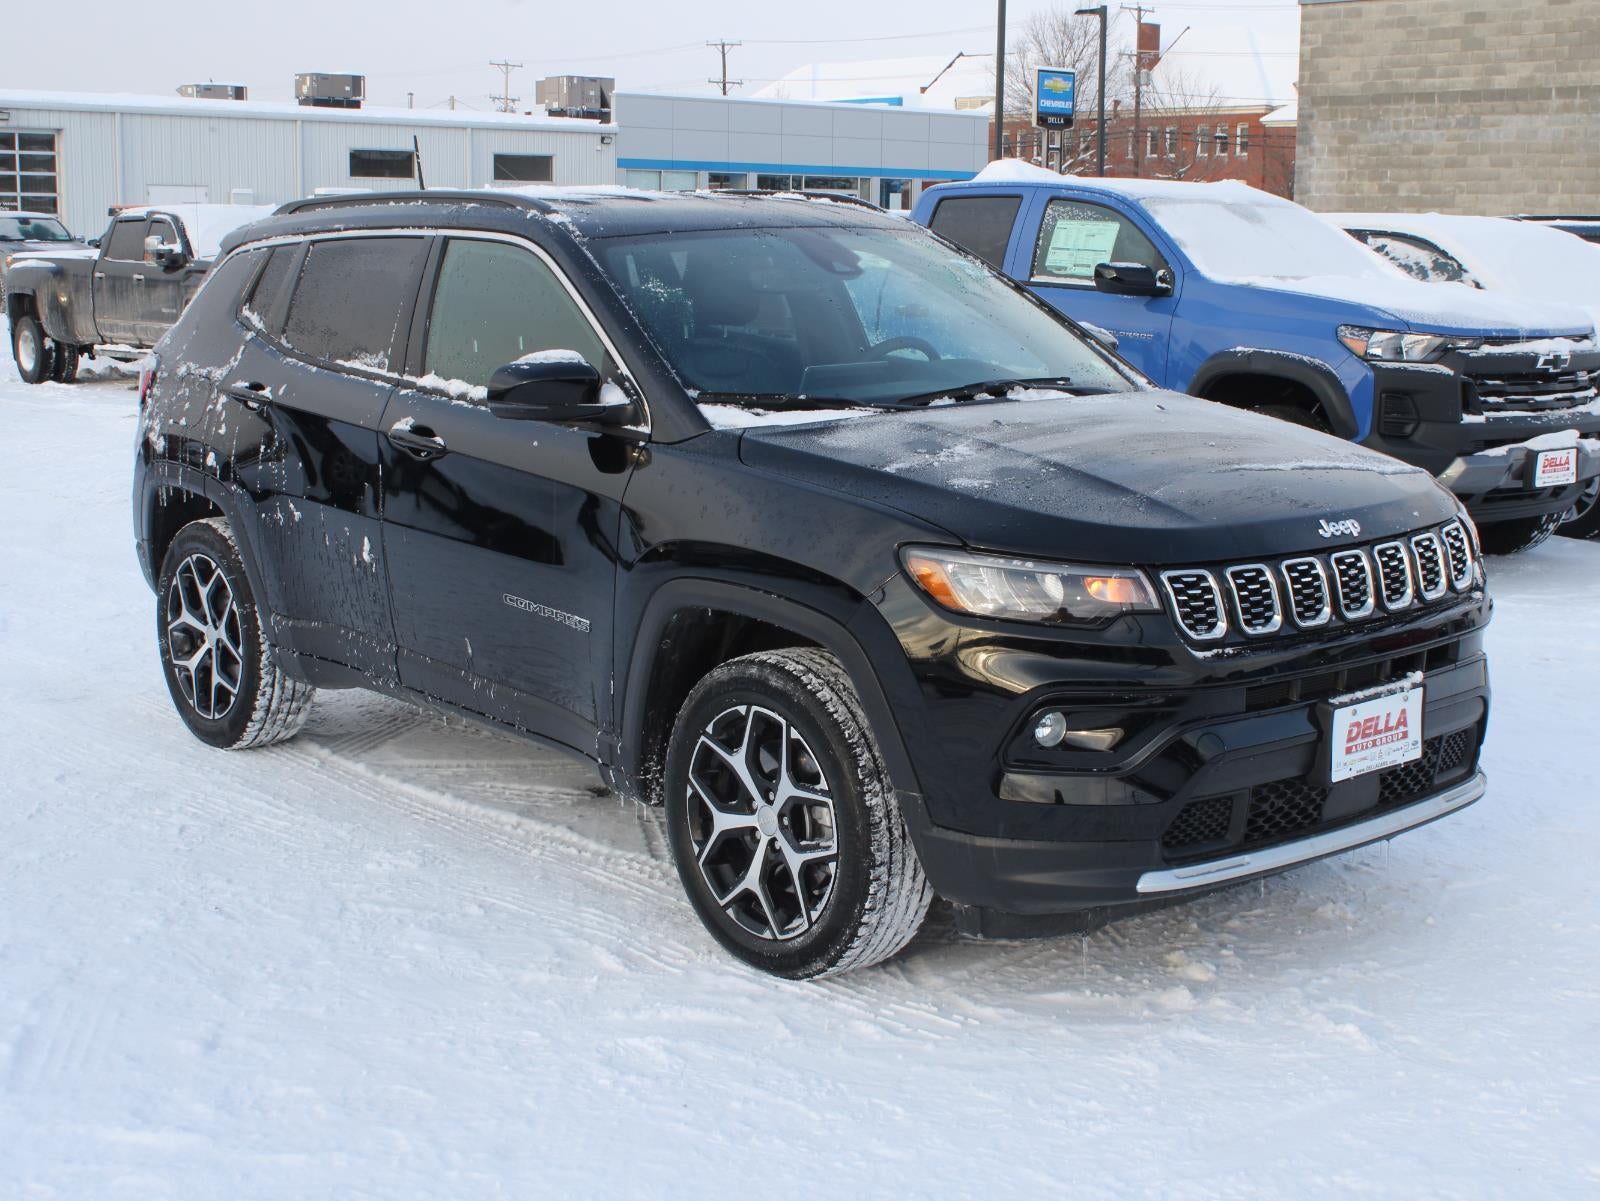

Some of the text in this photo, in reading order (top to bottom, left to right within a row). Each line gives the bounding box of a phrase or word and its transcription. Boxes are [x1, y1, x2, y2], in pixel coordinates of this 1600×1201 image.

[1040, 99, 1073, 109] CHEVROLET
[1047, 116, 1064, 124] DELLA
[1542, 455, 1570, 469] DELLA
[1318, 518, 1361, 538] Jeep
[503, 593, 591, 633] COMPASS
[1345, 708, 1409, 744] DELLA
[1351, 732, 1403, 753] AUTO GROUP
